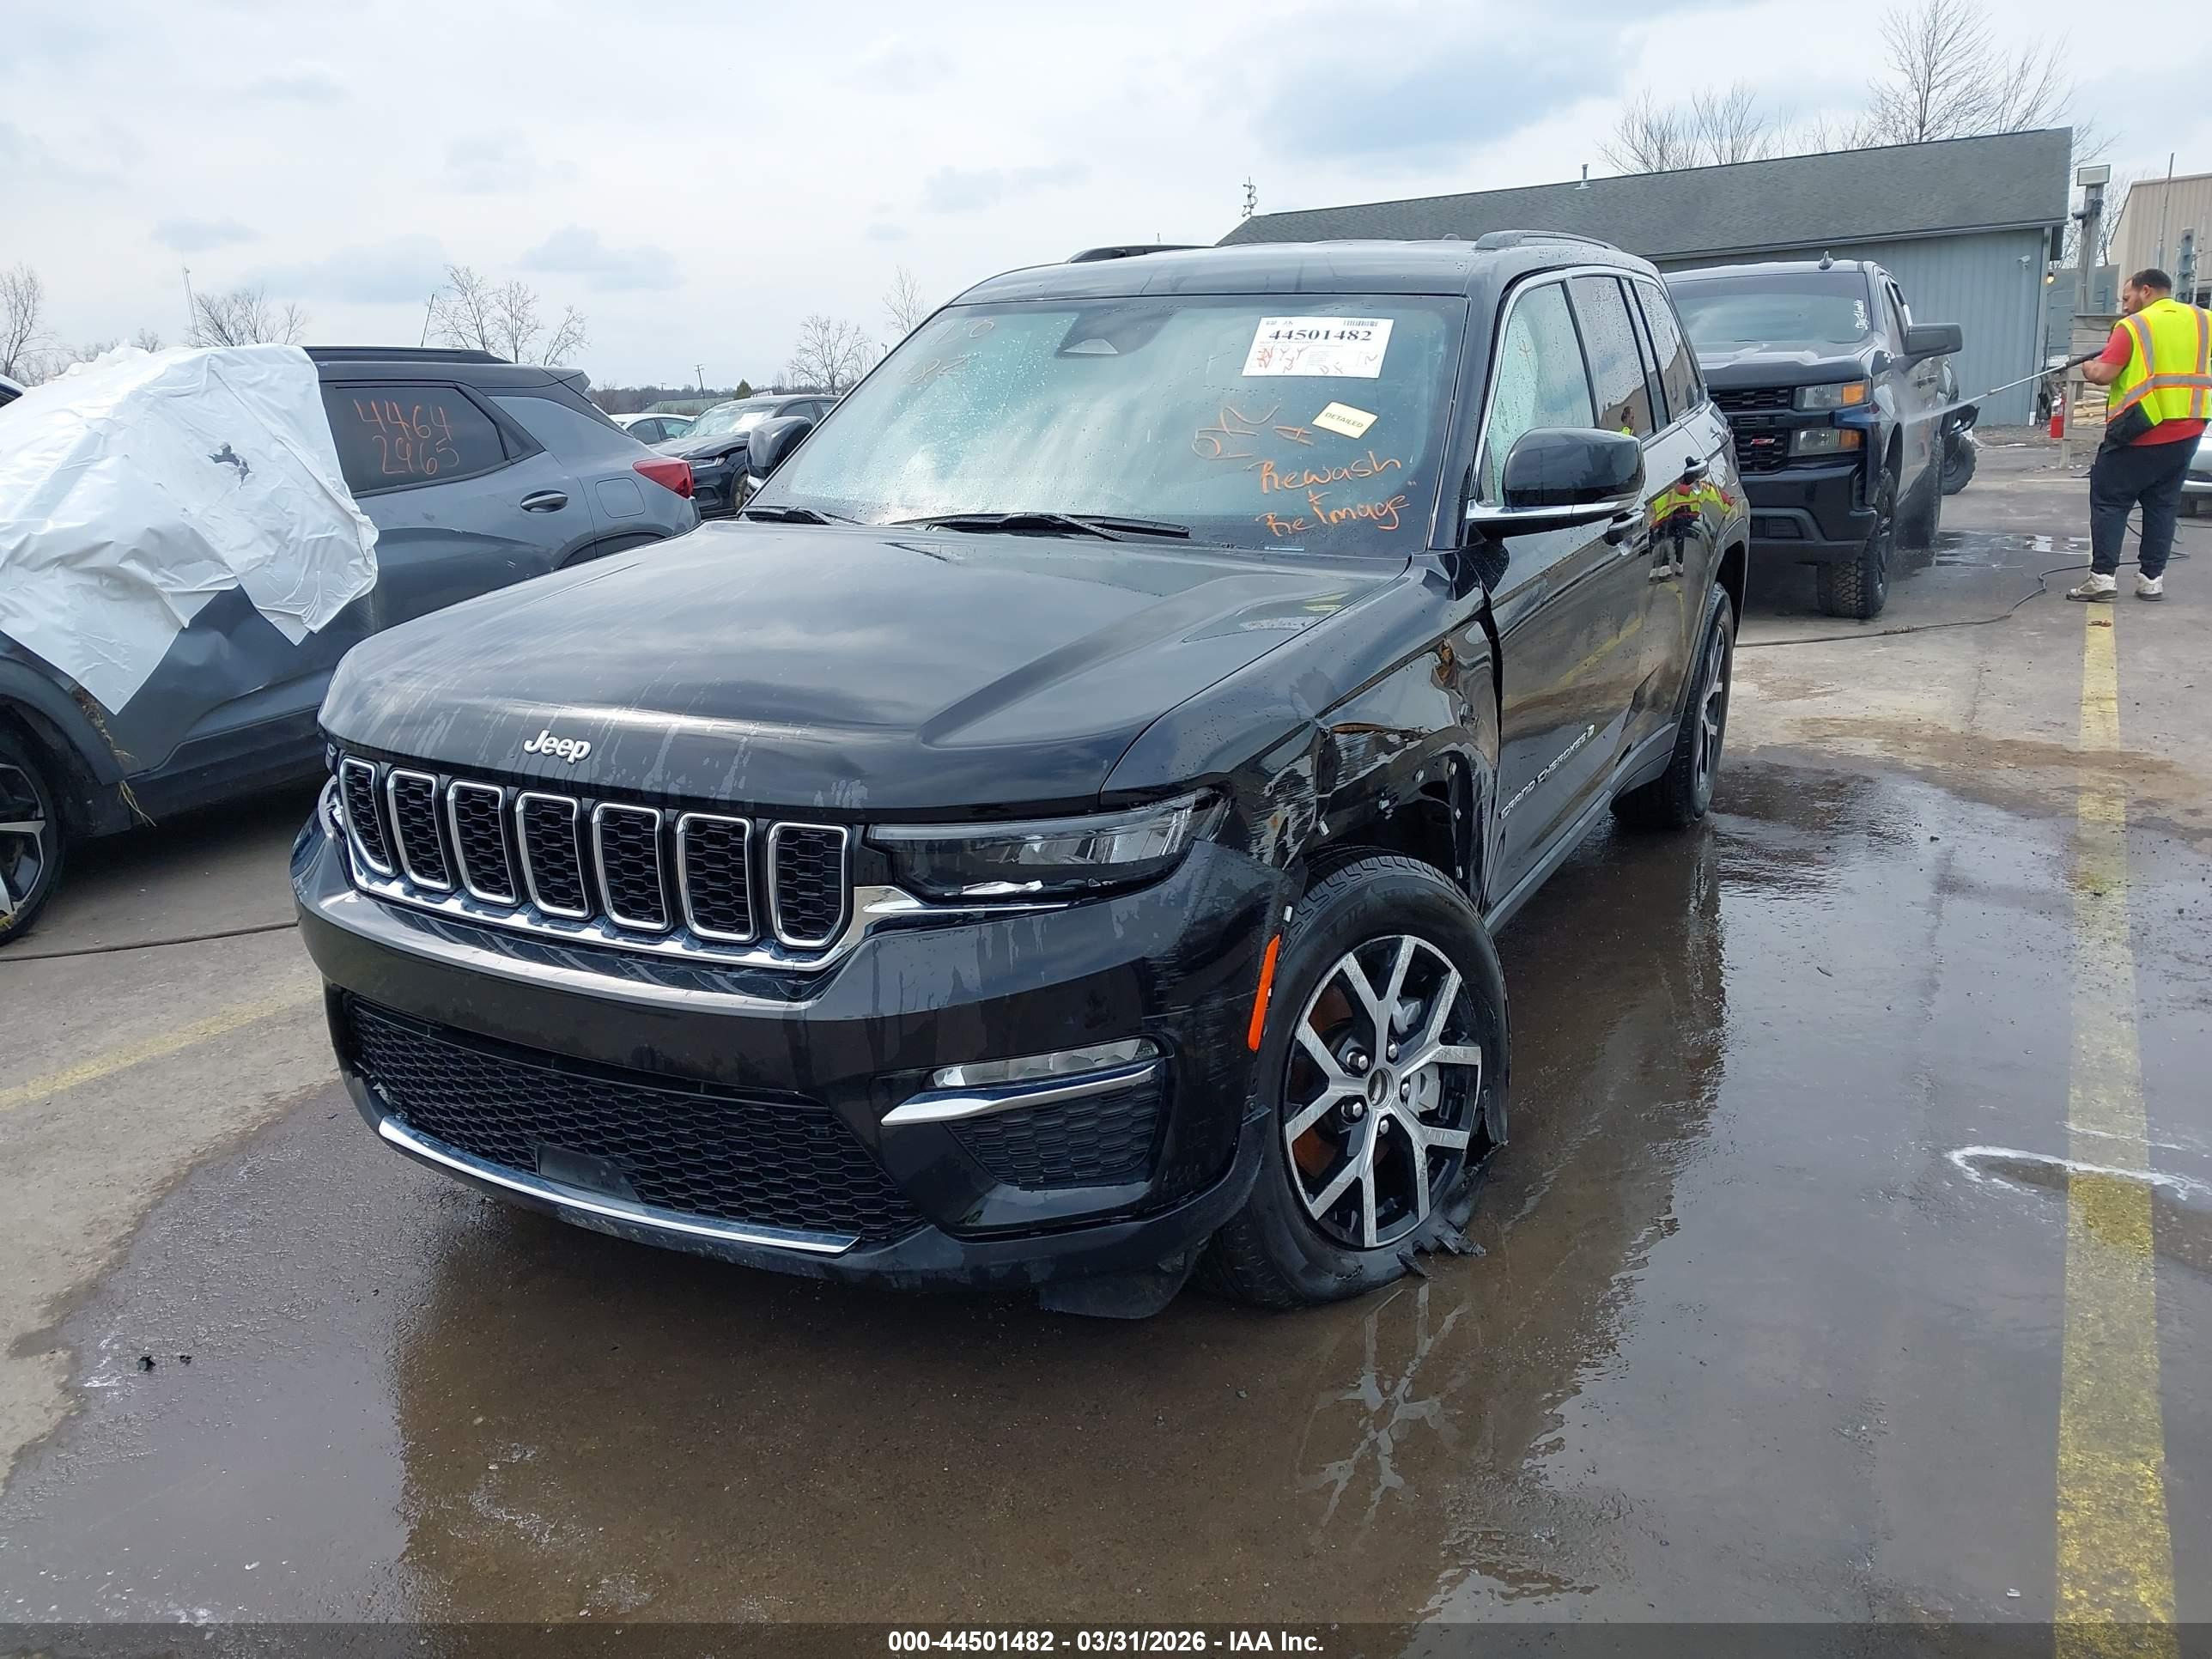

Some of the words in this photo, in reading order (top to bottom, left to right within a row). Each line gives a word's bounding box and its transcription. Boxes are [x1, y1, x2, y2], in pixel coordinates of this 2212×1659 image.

[1268, 329, 1372, 342] 44501482
[353, 398, 453, 441] 4464
[1325, 412, 1364, 428] DETAILED
[372, 434, 459, 475] 2965
[1243, 451, 1401, 494] Rewash
[524, 729, 592, 764] Jeep
